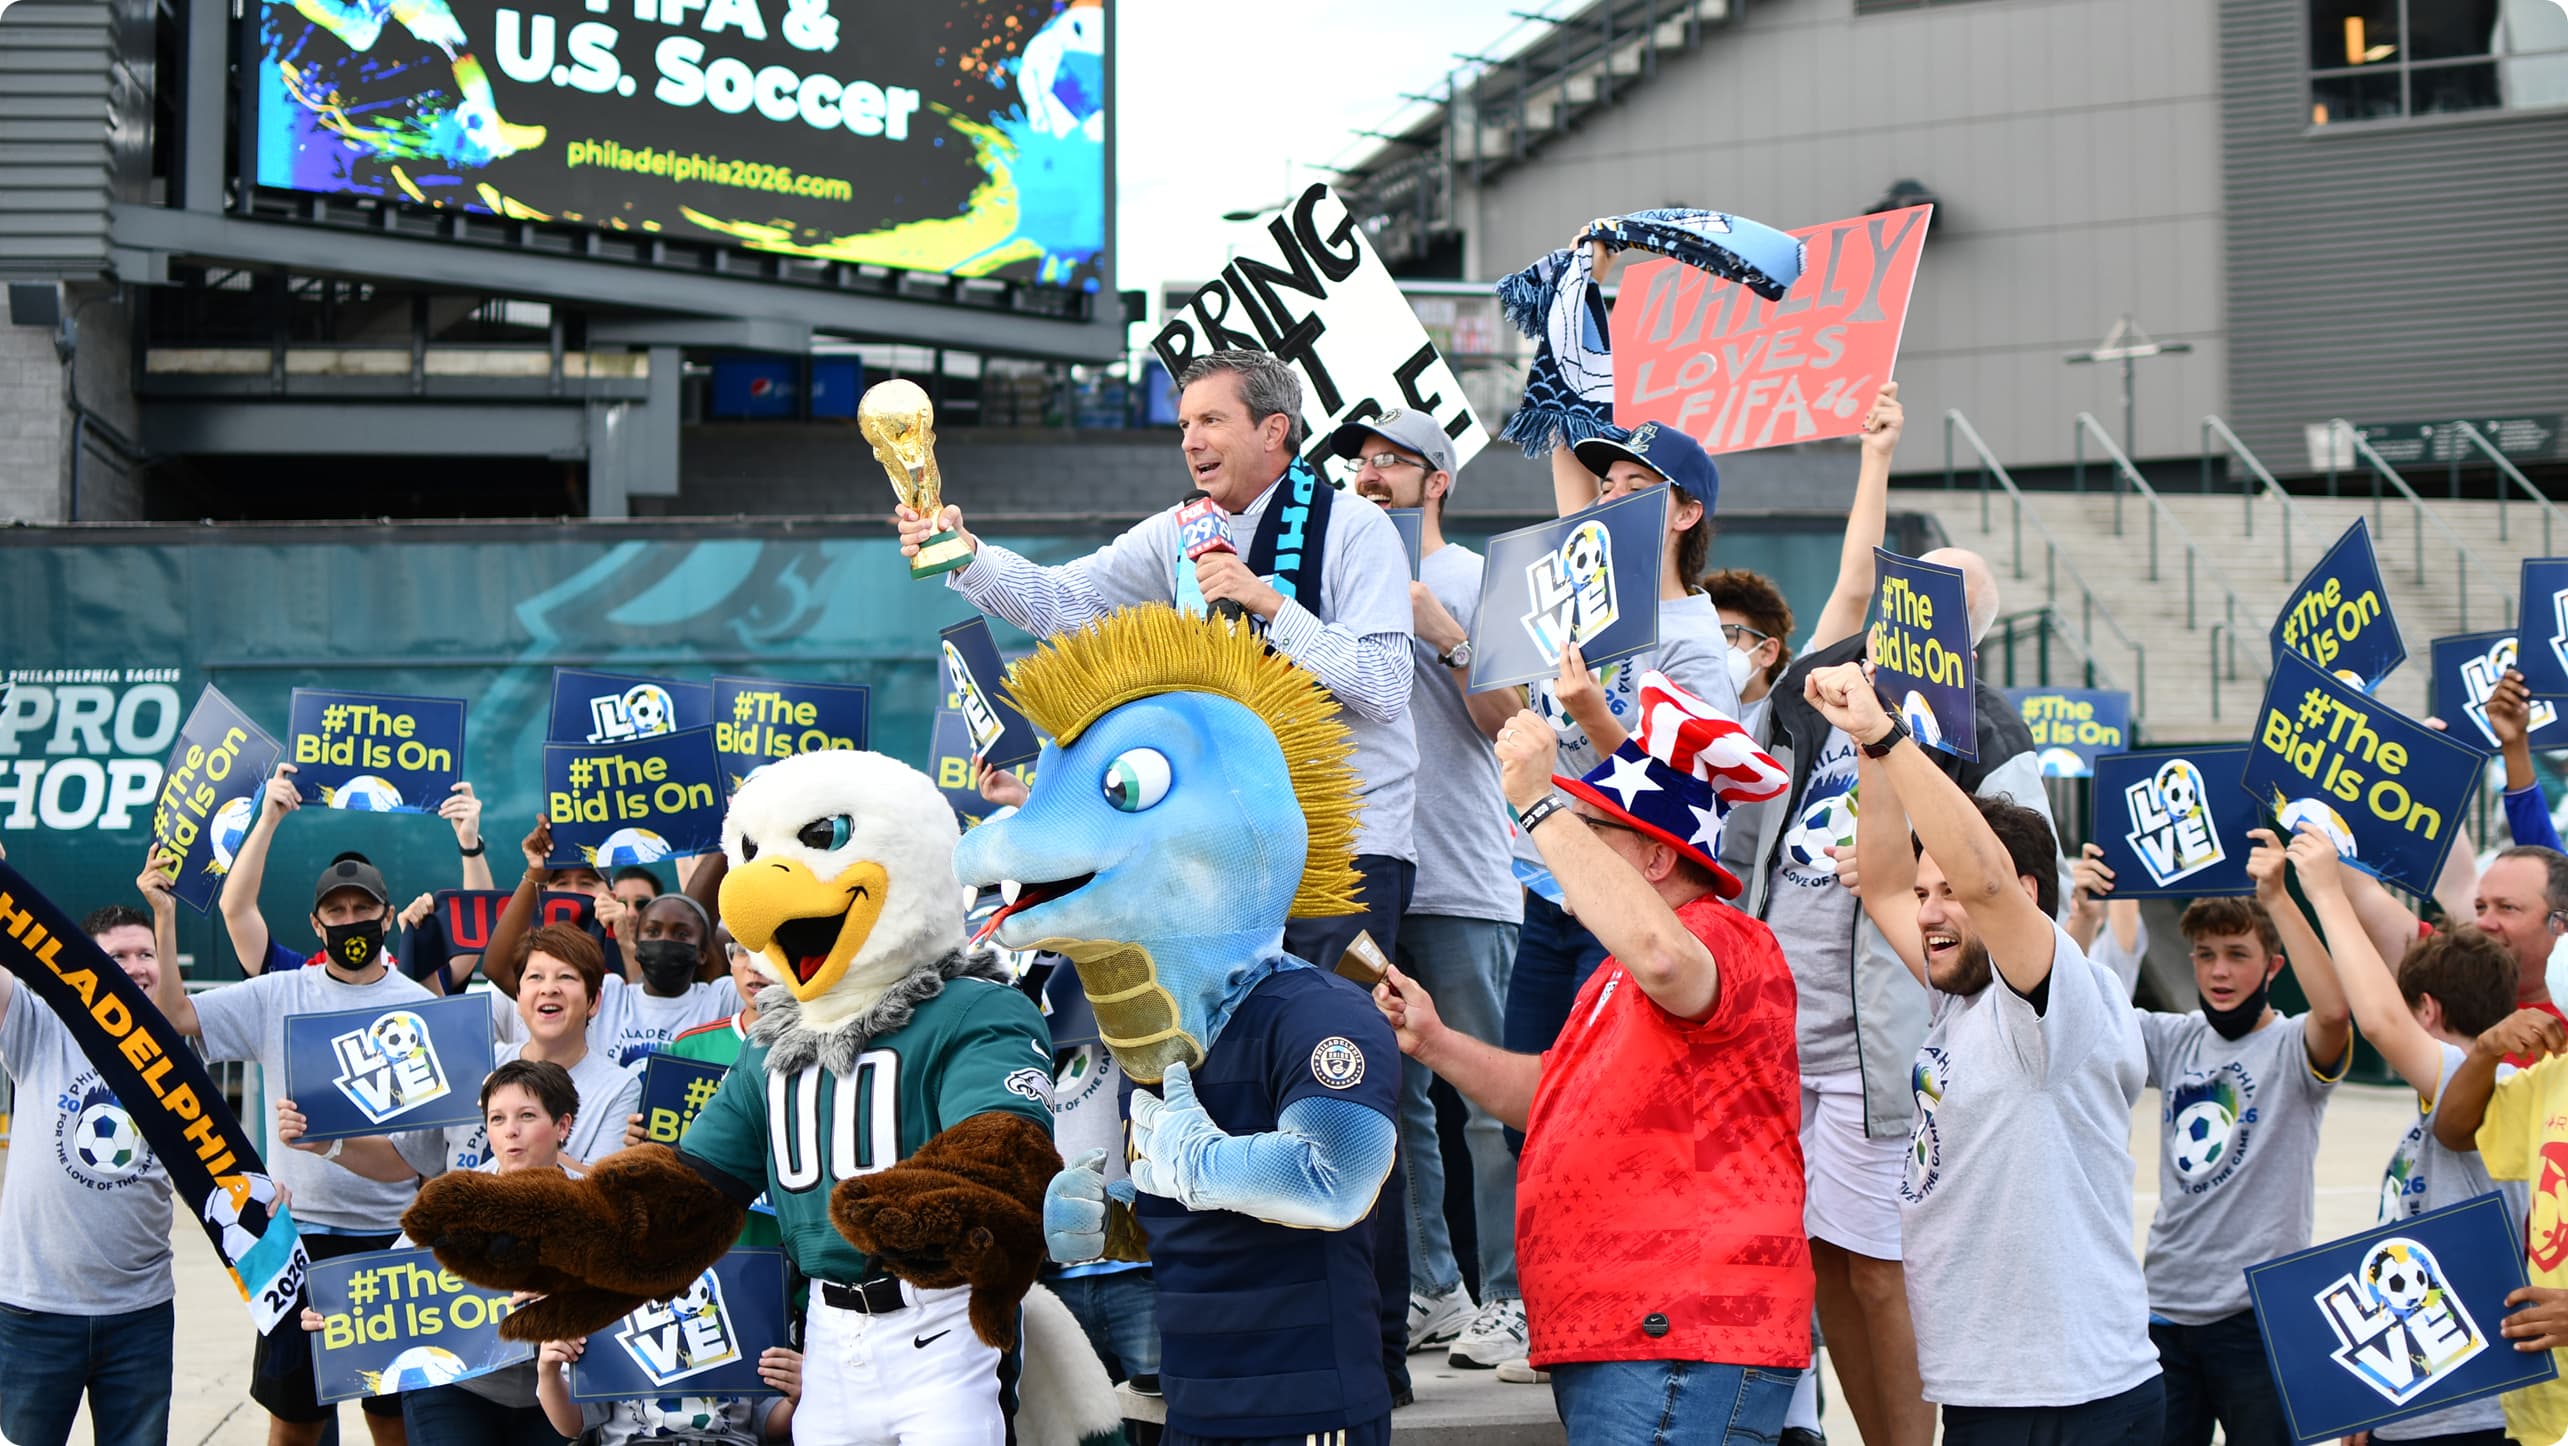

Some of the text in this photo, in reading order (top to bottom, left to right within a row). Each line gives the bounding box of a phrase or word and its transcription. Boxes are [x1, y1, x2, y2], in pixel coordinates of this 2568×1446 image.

[494, 8, 637, 98] U.S.
[654, 35, 920, 141] Soccer
[567, 138, 853, 202] philadelphia2026.com
[1631, 325, 1847, 405] LOVES
[1673, 374, 1817, 447] FIFA
[1183, 517, 1213, 548] 29
[1882, 575, 1933, 630] #The
[2282, 577, 2342, 649] #The
[2311, 590, 2381, 668] Is On
[1874, 620, 1965, 689] Bid Is On
[9, 668, 181, 683] PHILADELPHIA EAGLES
[0, 683, 180, 755] PRO
[322, 704, 416, 738] #The
[733, 691, 818, 726] #The
[2022, 695, 2094, 720] #The
[716, 722, 752, 756] Bid
[765, 727, 793, 758] Is
[2051, 720, 2076, 744] Is
[2077, 721, 2120, 747] On
[2298, 687, 2409, 775] #The
[296, 733, 451, 772] Bid Is On
[569, 754, 668, 788] #The
[154, 743, 206, 838] #The
[2262, 708, 2442, 841] Bid Is On
[154, 726, 248, 882] Bid Is On
[550, 781, 714, 823] Bid Is On
[1811, 876, 1830, 887] OF
[57, 1094, 80, 1113] 20
[1065, 1097, 1081, 1111] OF
[1081, 1077, 1103, 1100] THE
[55, 1113, 67, 1137] FOR
[55, 1141, 69, 1165] THE
[456, 1153, 479, 1168] 20
[2192, 1129, 2250, 1194] OF THE GAME
[65, 1165, 95, 1189] LOVE
[97, 1181, 113, 1191] OF
[115, 1173, 141, 1189] THE
[1923, 1169, 1940, 1196] THE
[2401, 1176, 2427, 1196] 26
[264, 1248, 309, 1314] 2026
[348, 1262, 465, 1305] #The
[324, 1294, 515, 1350] Bid Is On
